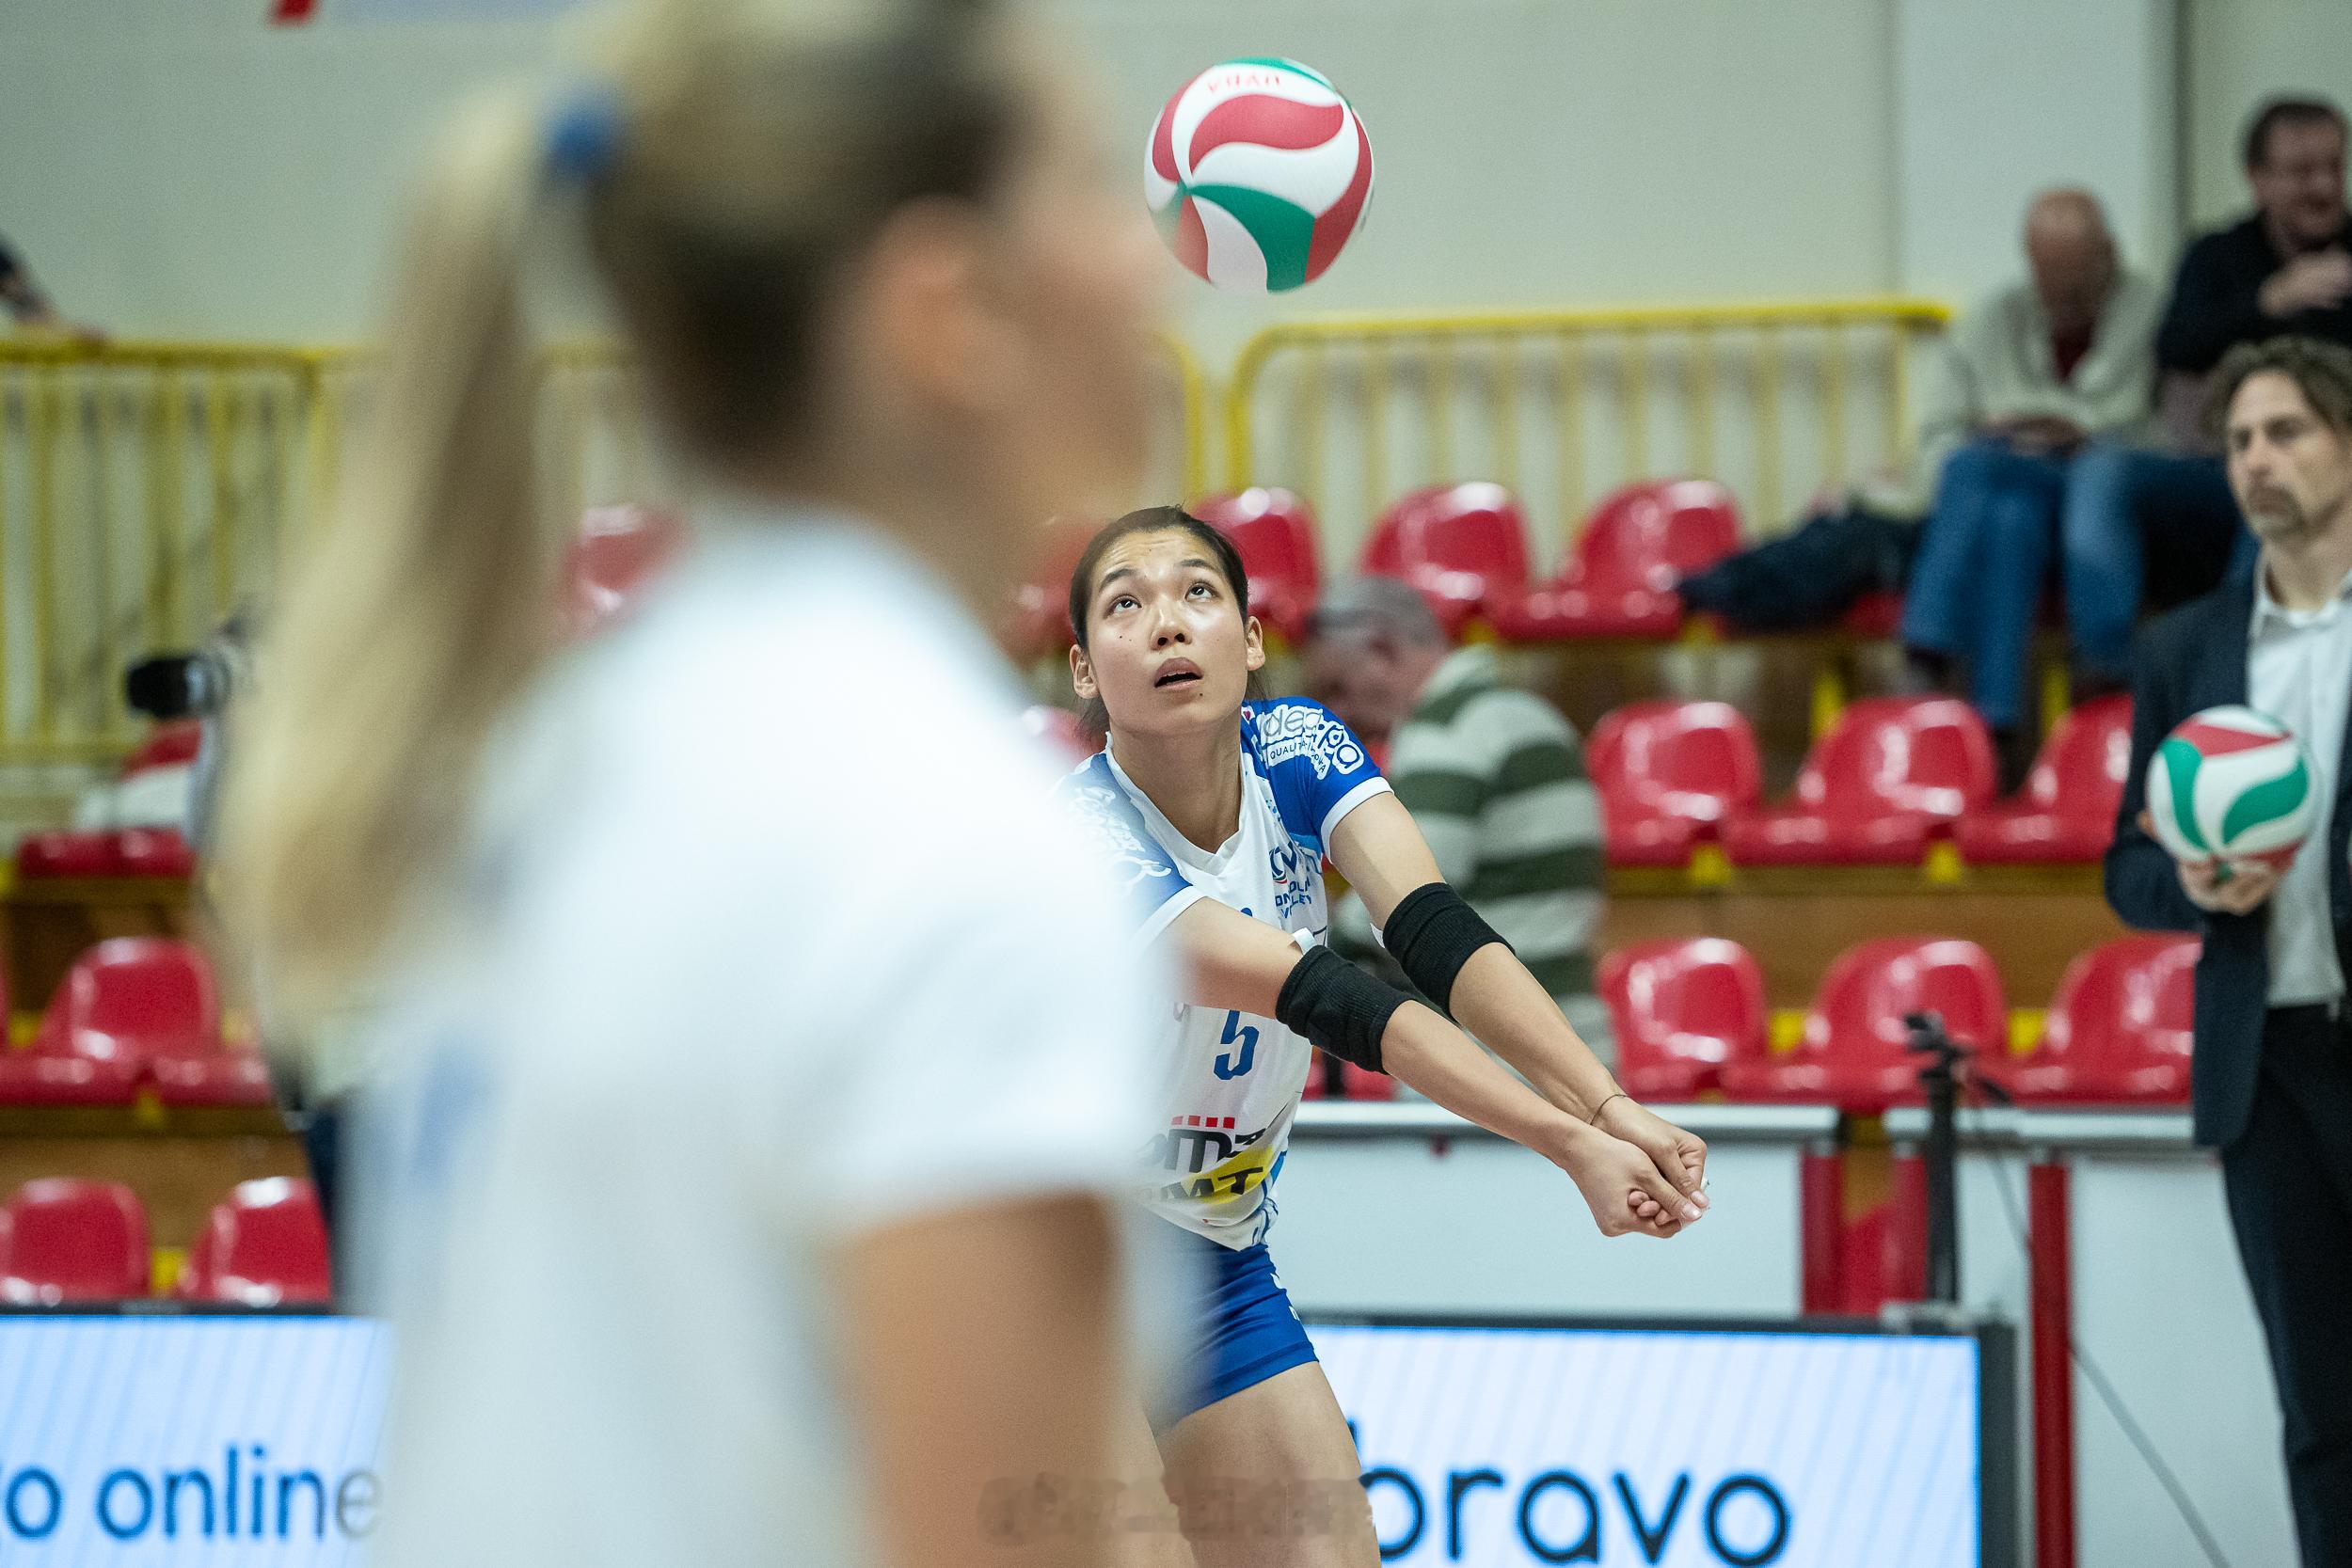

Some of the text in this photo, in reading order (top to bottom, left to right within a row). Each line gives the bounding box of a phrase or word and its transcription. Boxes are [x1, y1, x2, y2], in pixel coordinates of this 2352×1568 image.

[1214, 1009, 1260, 1081] 5
[5, 1445, 380, 1539] o online
[1347, 1420, 1788, 1568] bravo
